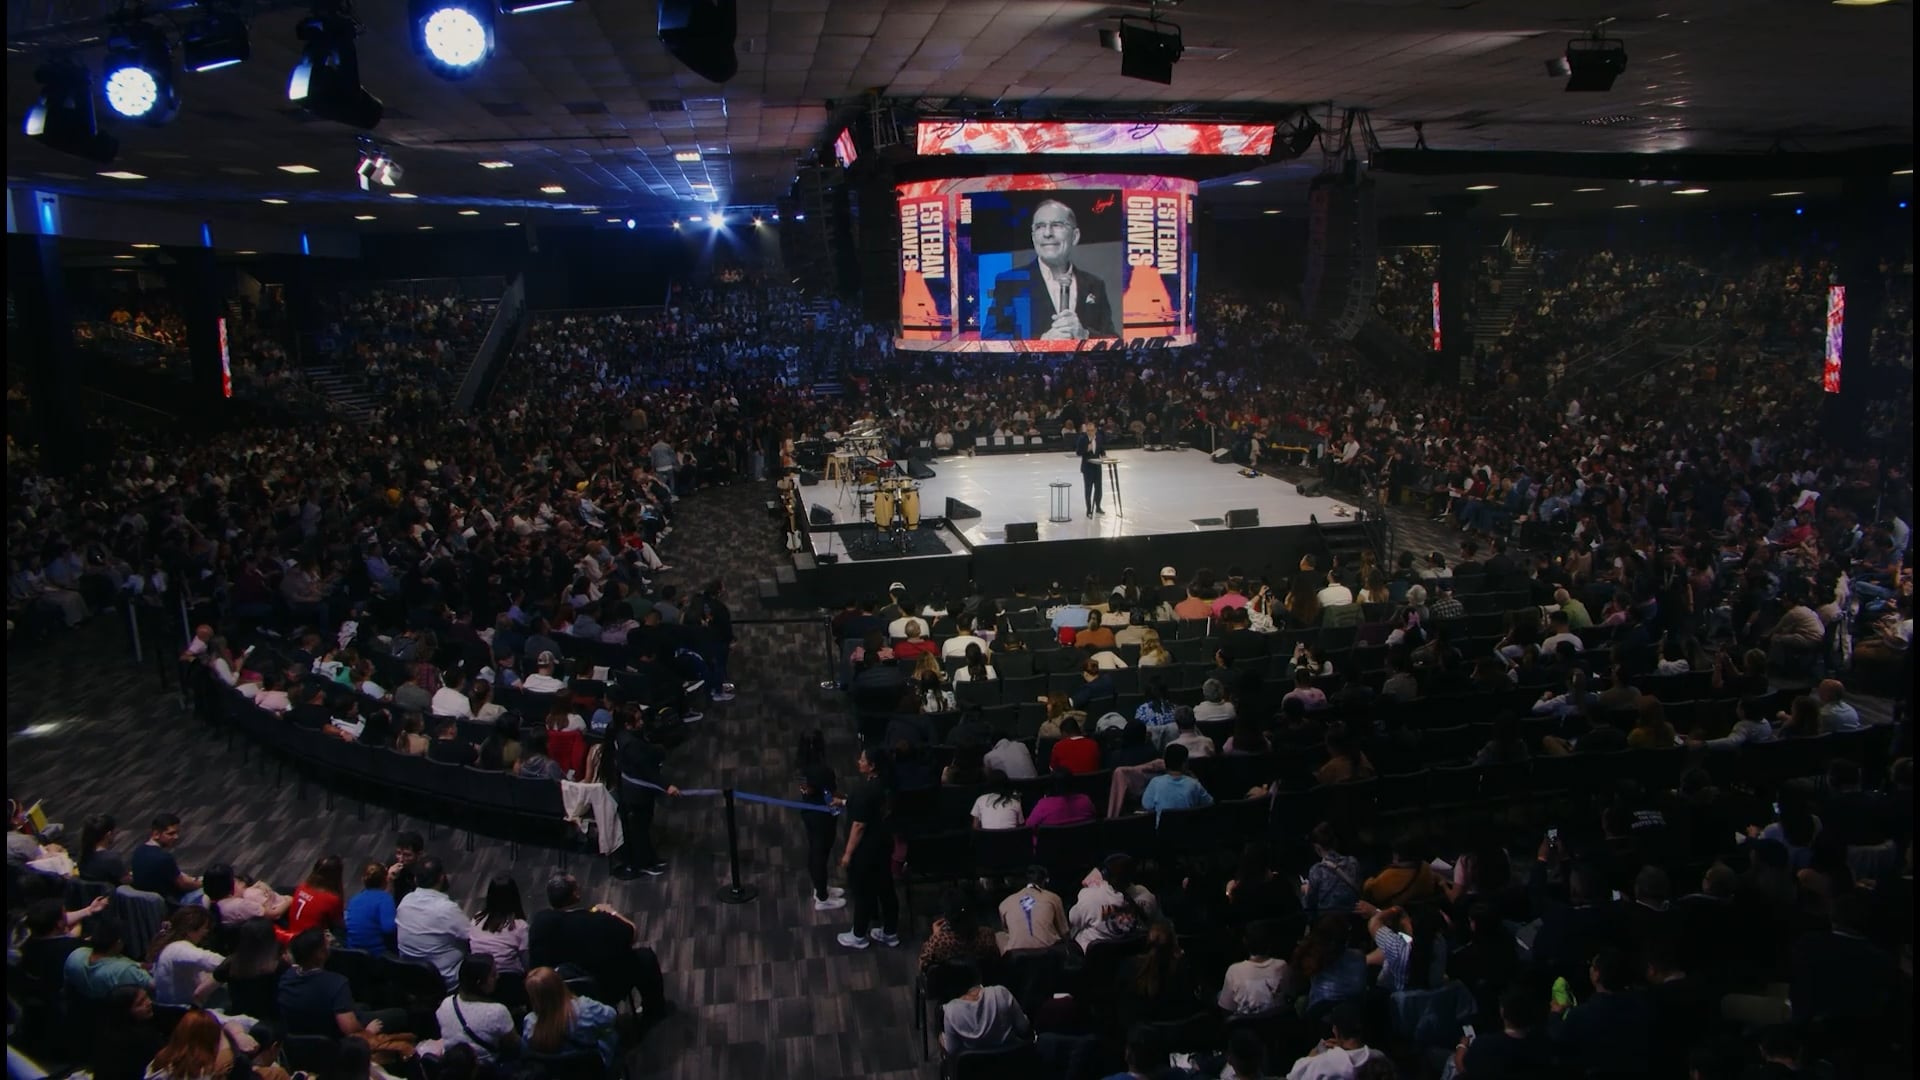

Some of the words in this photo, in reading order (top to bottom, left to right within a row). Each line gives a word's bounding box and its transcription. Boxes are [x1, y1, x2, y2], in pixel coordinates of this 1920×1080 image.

[901, 203, 919, 272] CHAVES
[920, 201, 944, 278] ESTEBAN
[1127, 195, 1154, 267] CHAVES
[1157, 197, 1178, 274] ESTEBAN
[296, 898, 306, 920] 7
